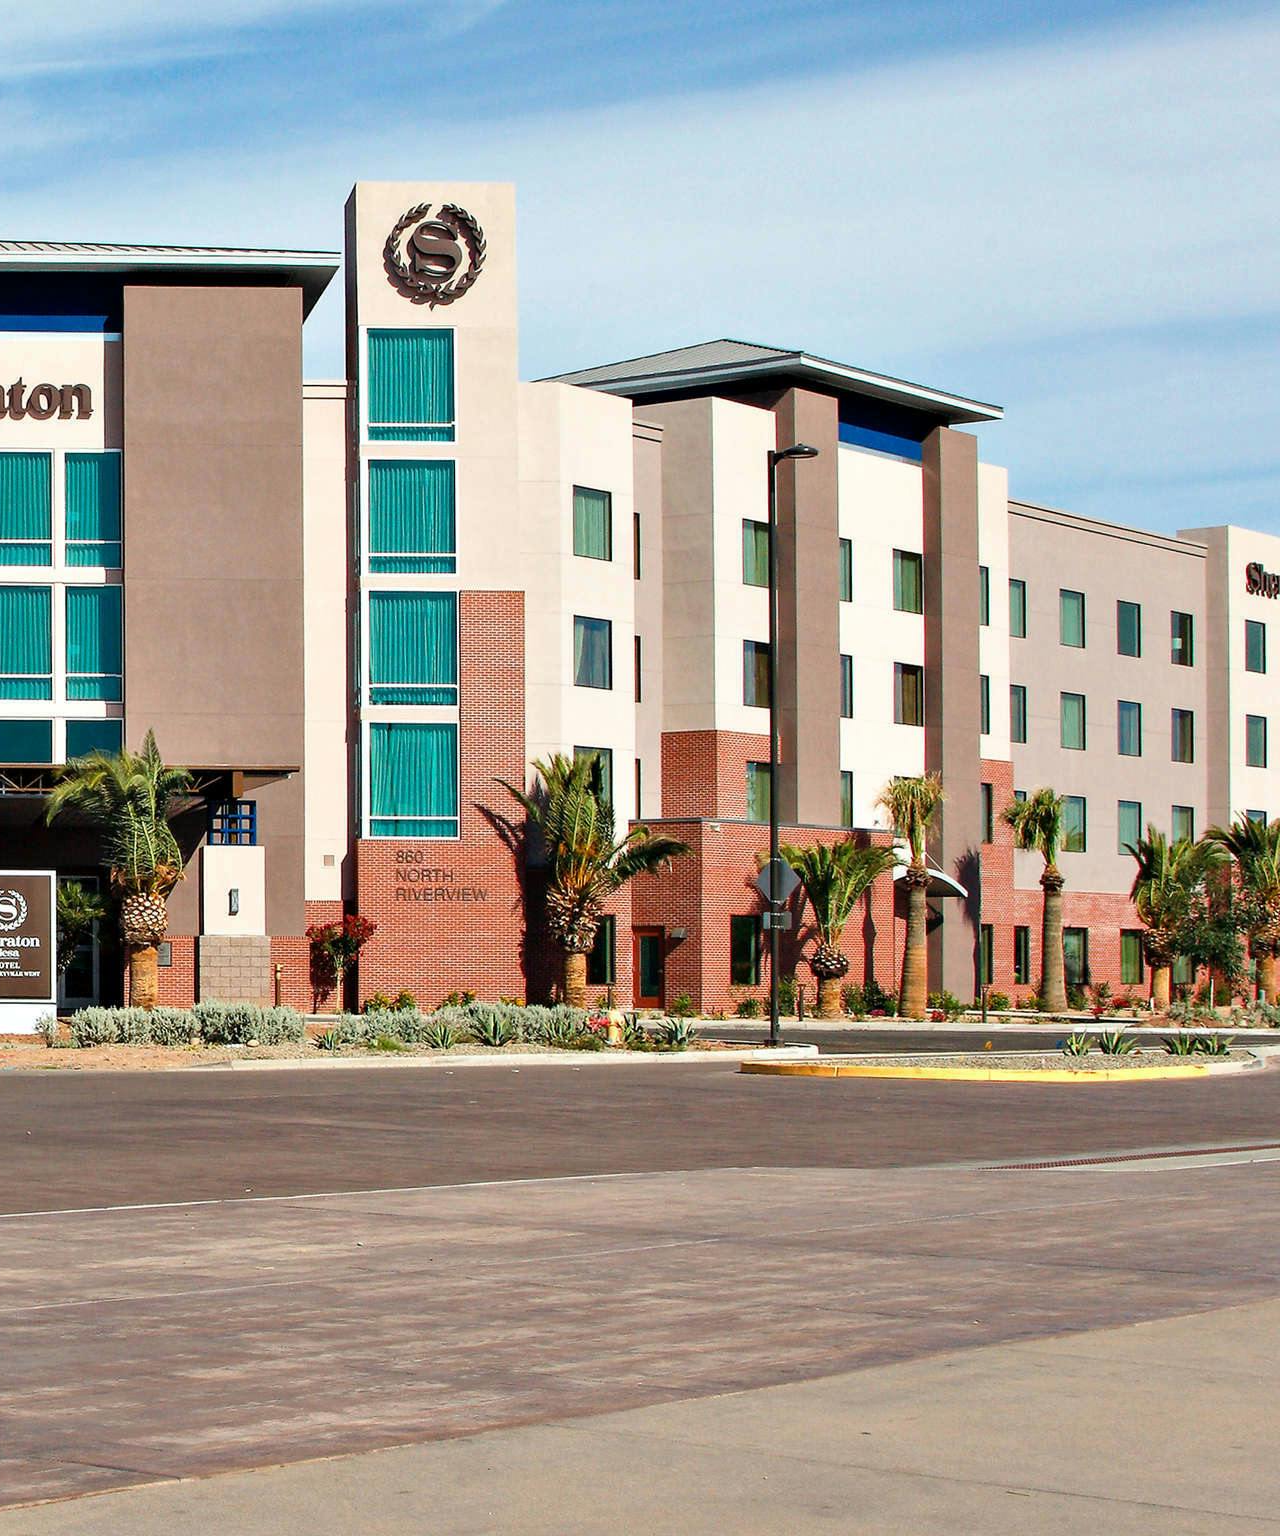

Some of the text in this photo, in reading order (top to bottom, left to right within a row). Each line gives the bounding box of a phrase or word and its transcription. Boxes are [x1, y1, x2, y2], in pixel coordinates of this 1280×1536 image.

[407, 220, 462, 284] S
[395, 850, 424, 864] 860
[395, 869, 454, 883] NORTH
[395, 887, 487, 901] RIVERVIEW
